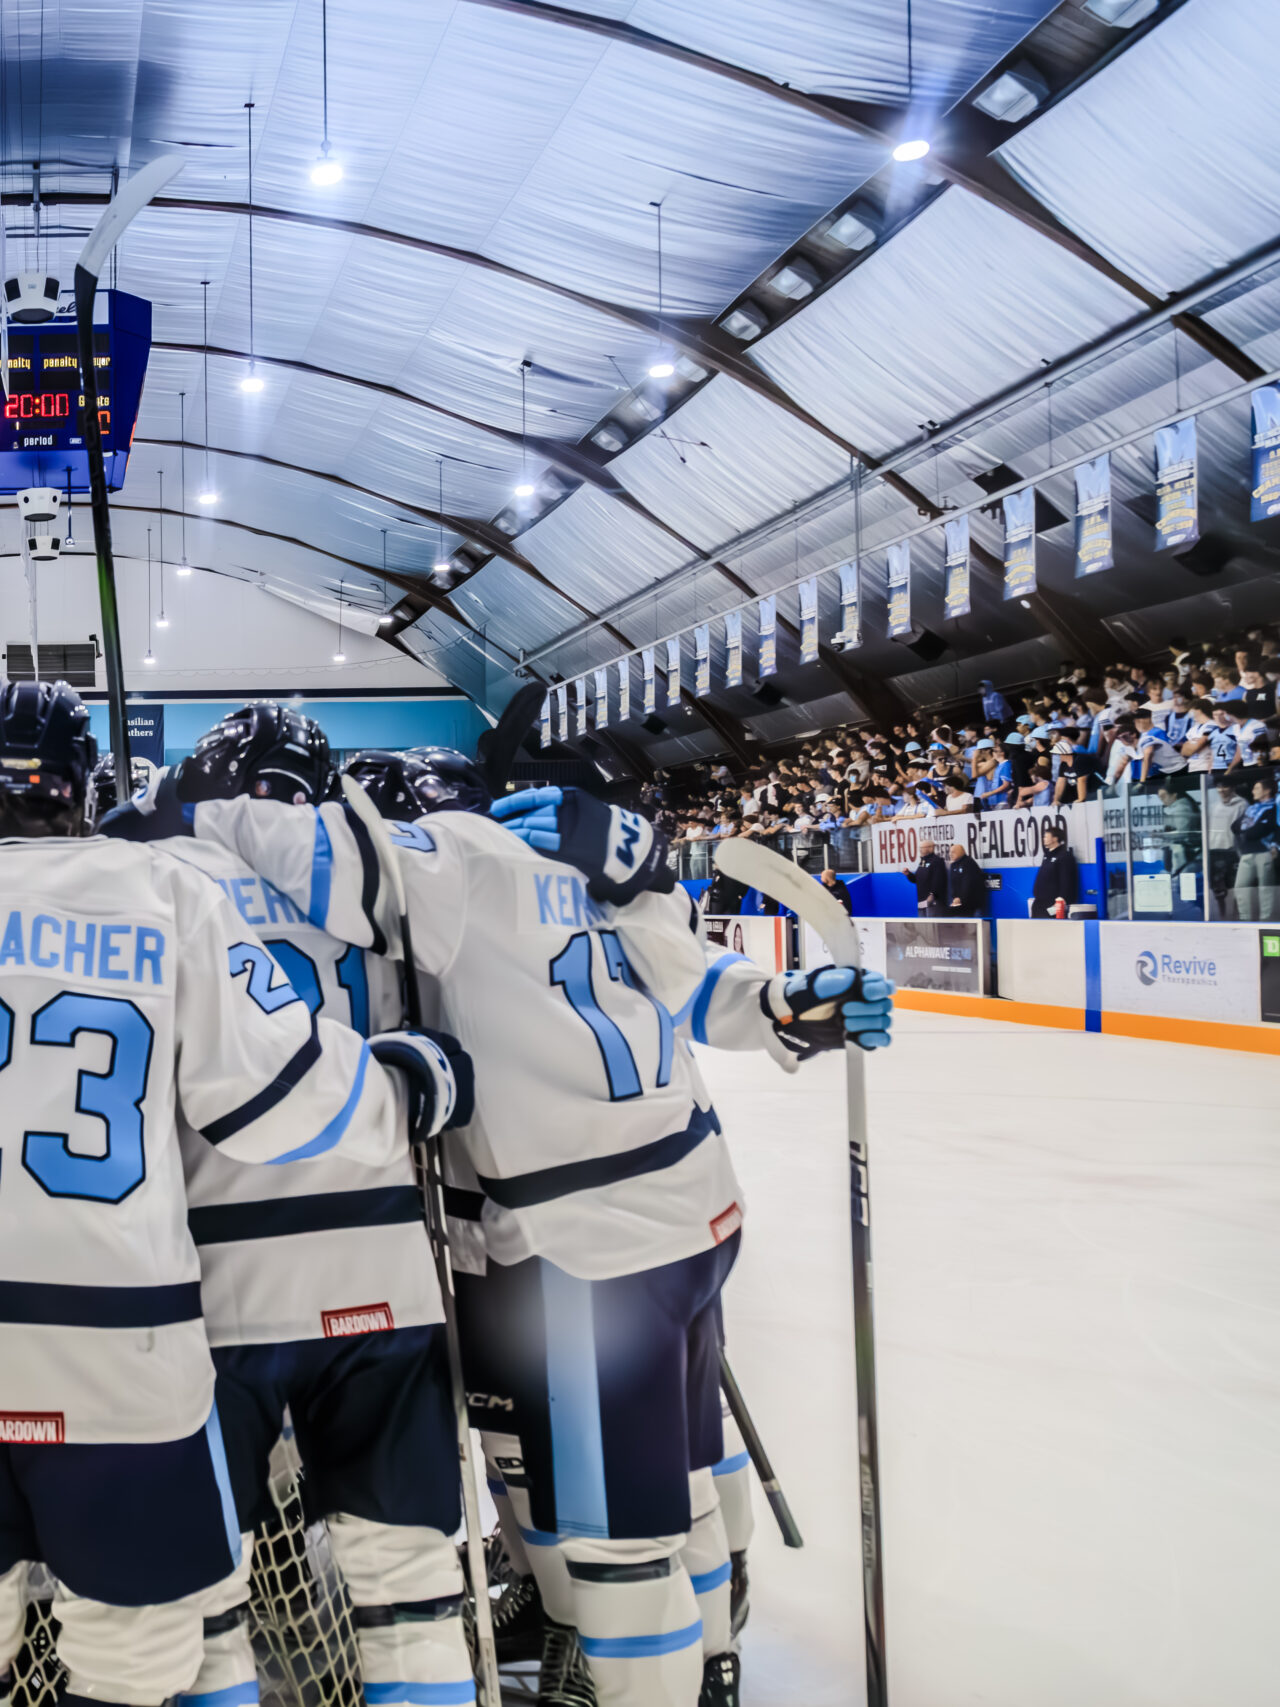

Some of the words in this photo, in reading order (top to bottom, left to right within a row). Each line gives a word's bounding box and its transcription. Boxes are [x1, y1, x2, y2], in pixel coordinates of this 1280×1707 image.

[43, 356, 78, 369] penalty
[5, 393, 70, 419] 20:00
[23, 435, 53, 446] period
[878, 826, 917, 865] HERO
[905, 945, 951, 960] ALPHAWAVE
[1161, 953, 1217, 976] Revive
[227, 941, 301, 1015] 2
[329, 1311, 389, 1337] BARDOWN
